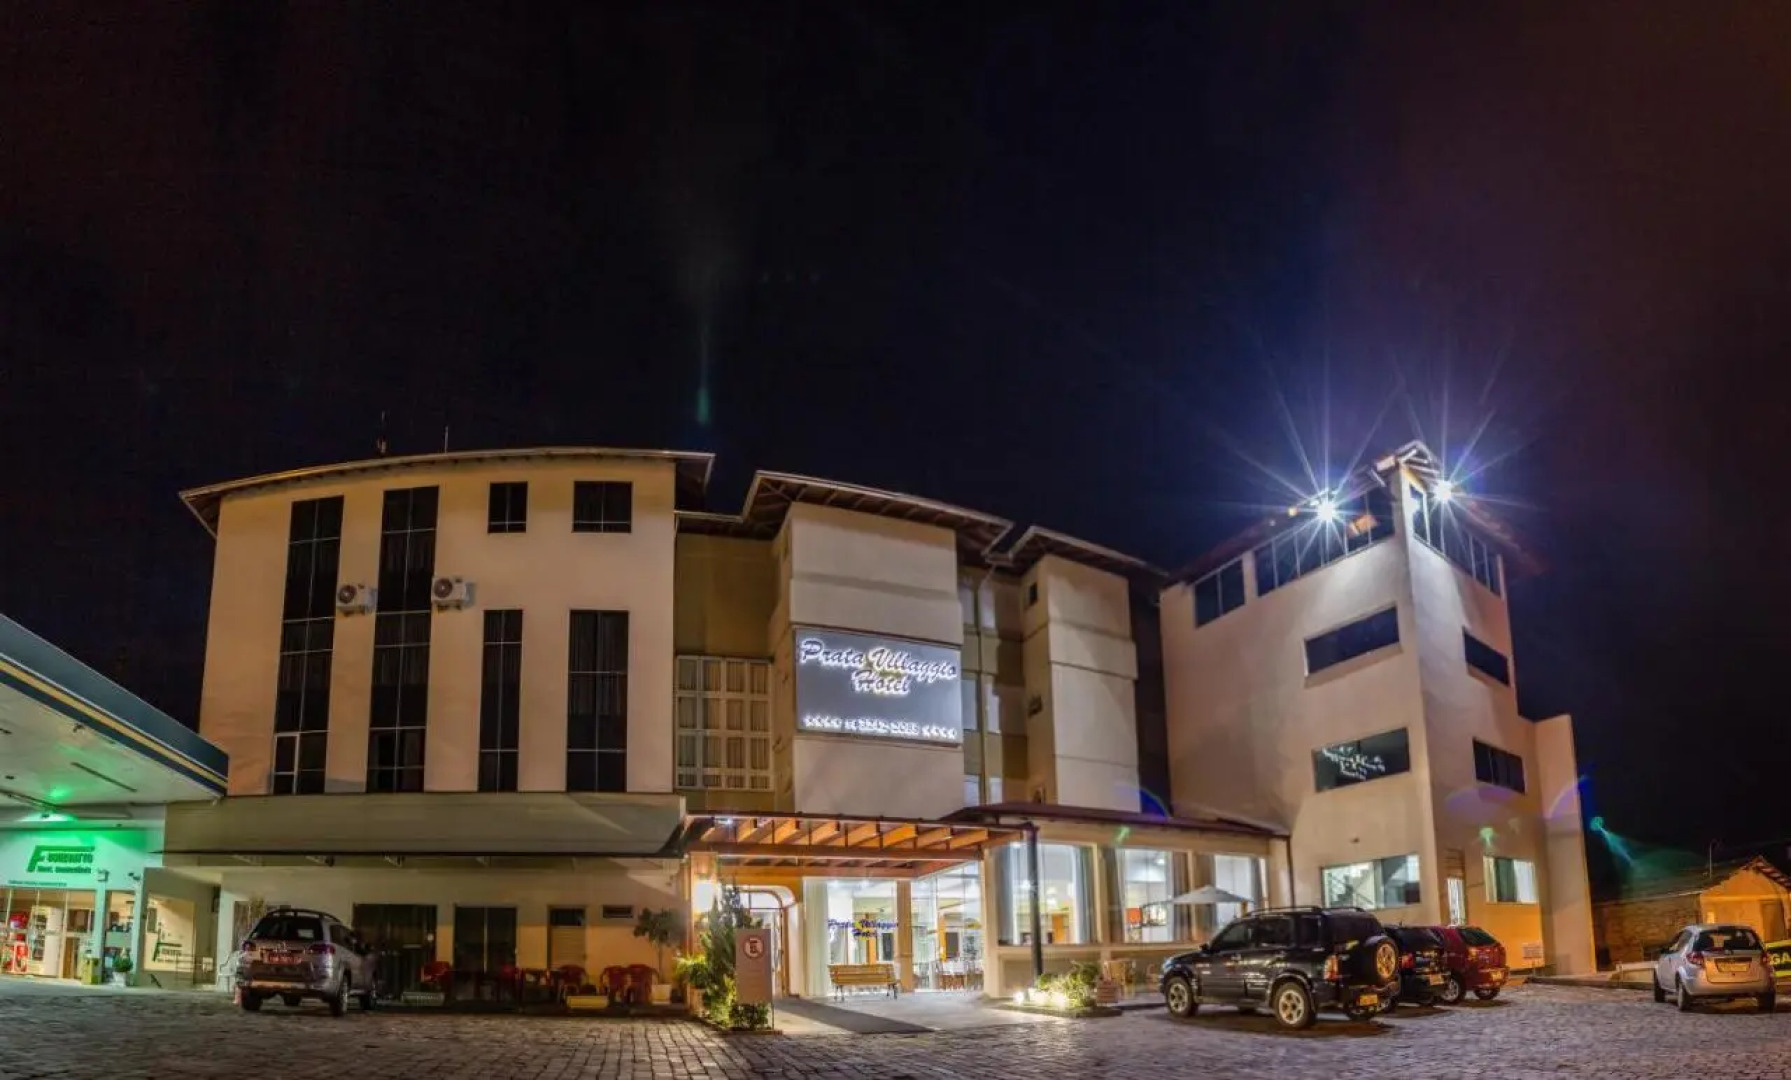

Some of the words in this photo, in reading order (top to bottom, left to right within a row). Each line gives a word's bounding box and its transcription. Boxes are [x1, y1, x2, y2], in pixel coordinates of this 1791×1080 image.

[800, 638, 864, 668] Prata
[868, 647, 957, 683] Villaggio
[851, 670, 910, 695] Hotel
